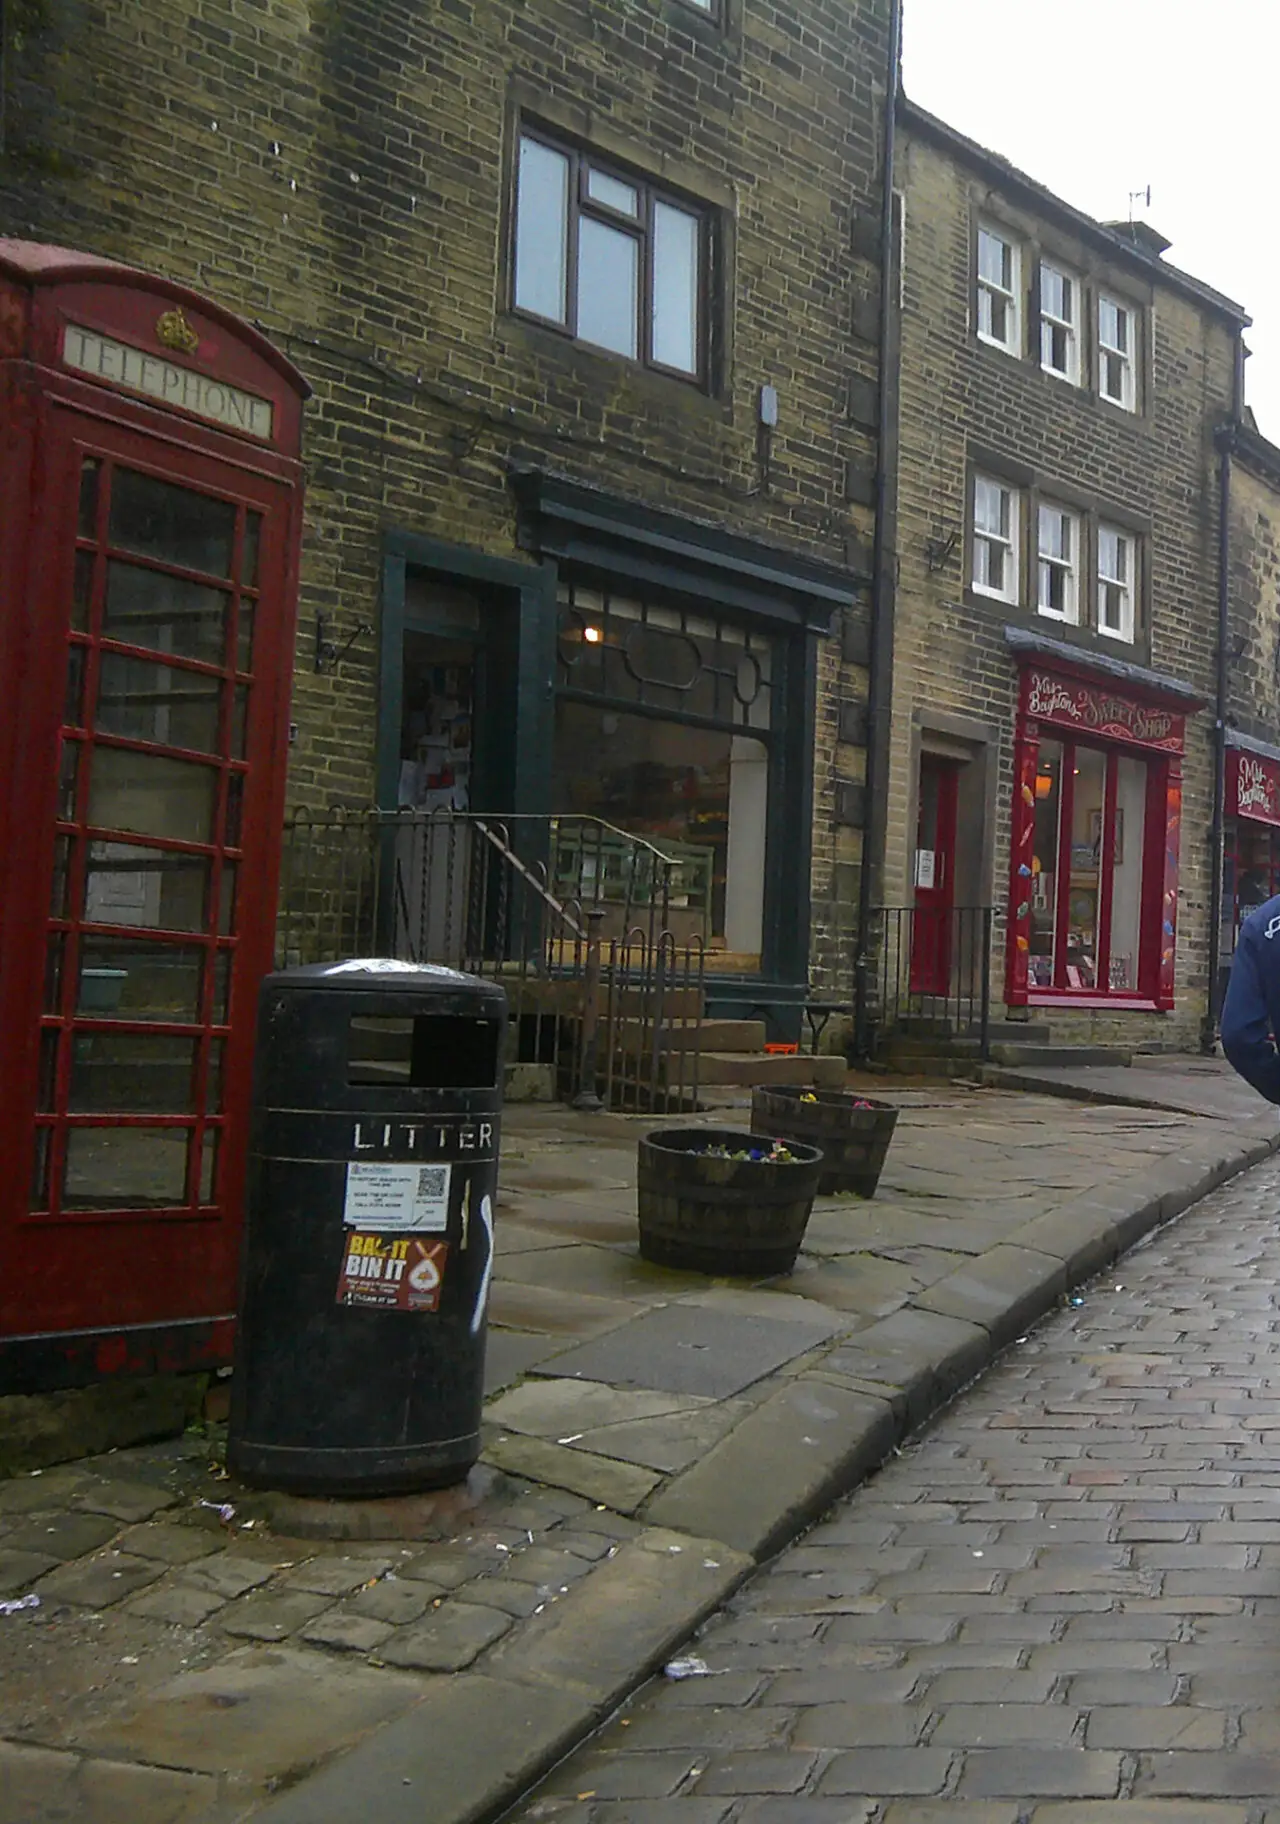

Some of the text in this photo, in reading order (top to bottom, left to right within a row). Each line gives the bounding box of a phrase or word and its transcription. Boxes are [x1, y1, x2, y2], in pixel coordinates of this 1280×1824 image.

[73, 329, 264, 431] TELEPHONE
[1031, 673, 1062, 694] Mrs
[354, 1123, 492, 1149] LITTER
[391, 1239, 411, 1259] IT
[346, 1254, 407, 1280] BIN IT
